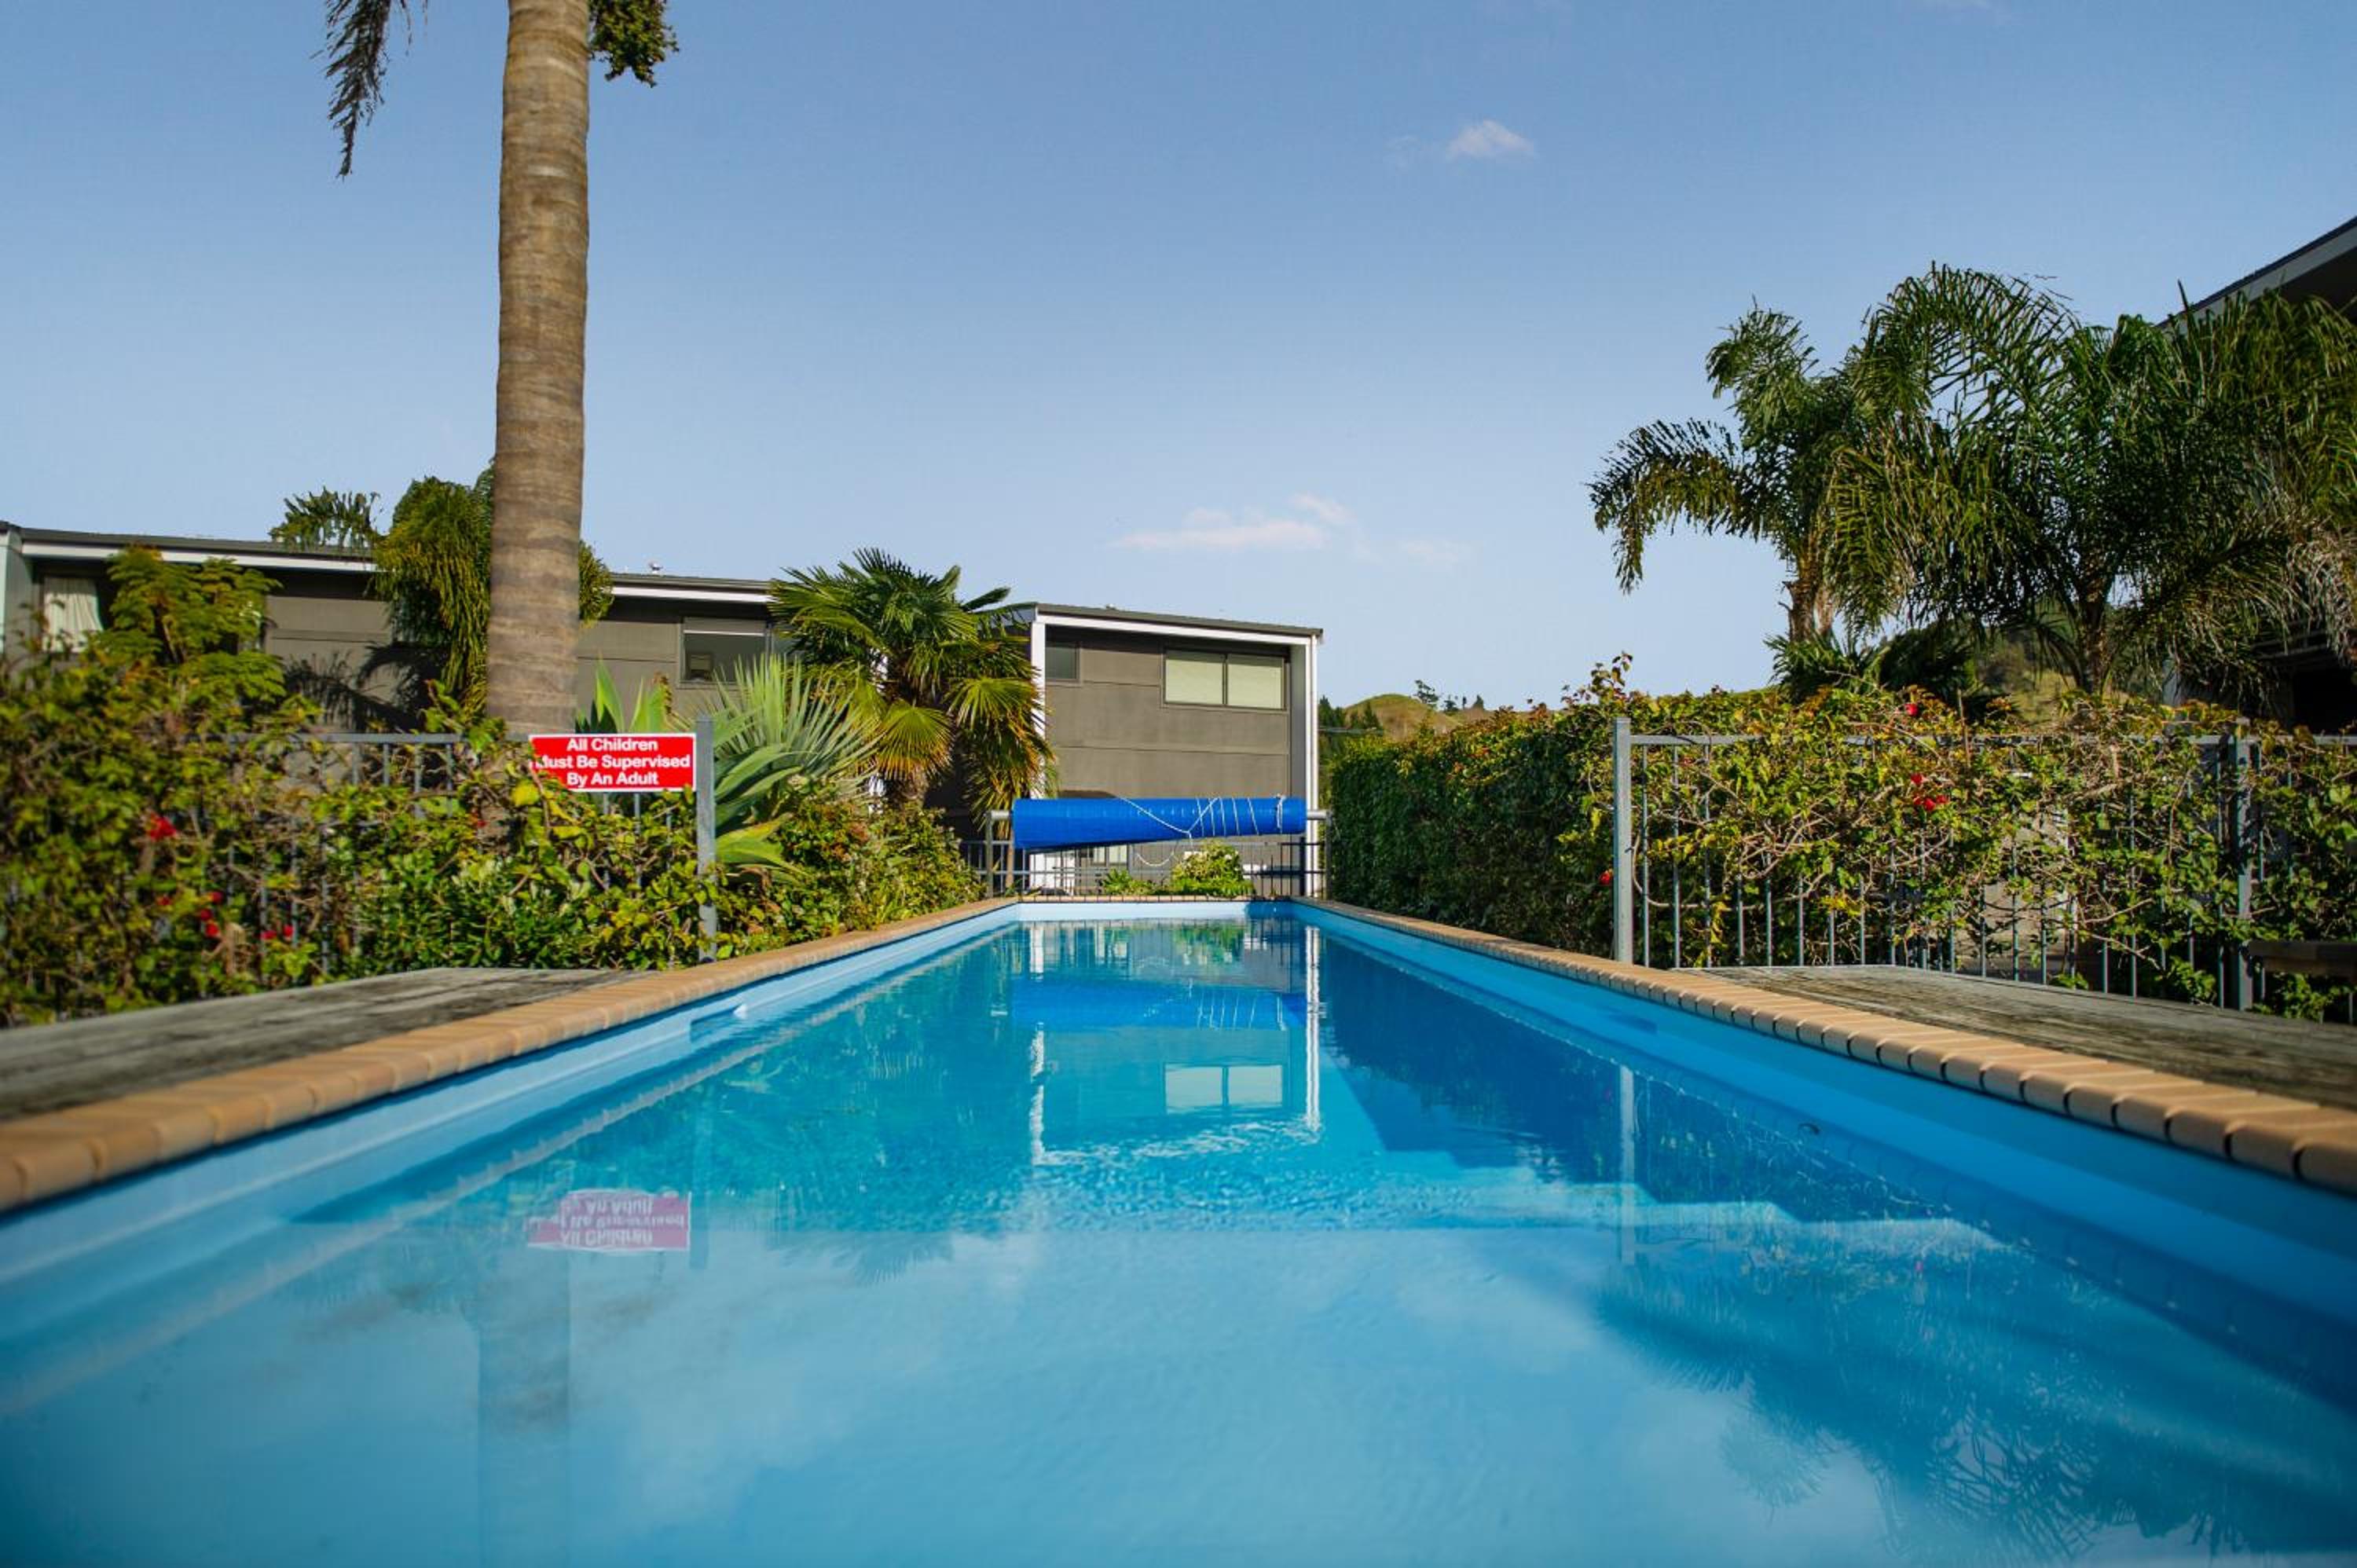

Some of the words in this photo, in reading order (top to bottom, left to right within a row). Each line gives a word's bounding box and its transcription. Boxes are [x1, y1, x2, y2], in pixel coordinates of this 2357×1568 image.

[566, 738, 588, 751] All
[591, 738, 658, 751] Children
[577, 755, 598, 768] Be
[602, 755, 691, 770] Supervised
[566, 772, 588, 788] By
[591, 772, 613, 785] An
[616, 772, 658, 785] Adult
